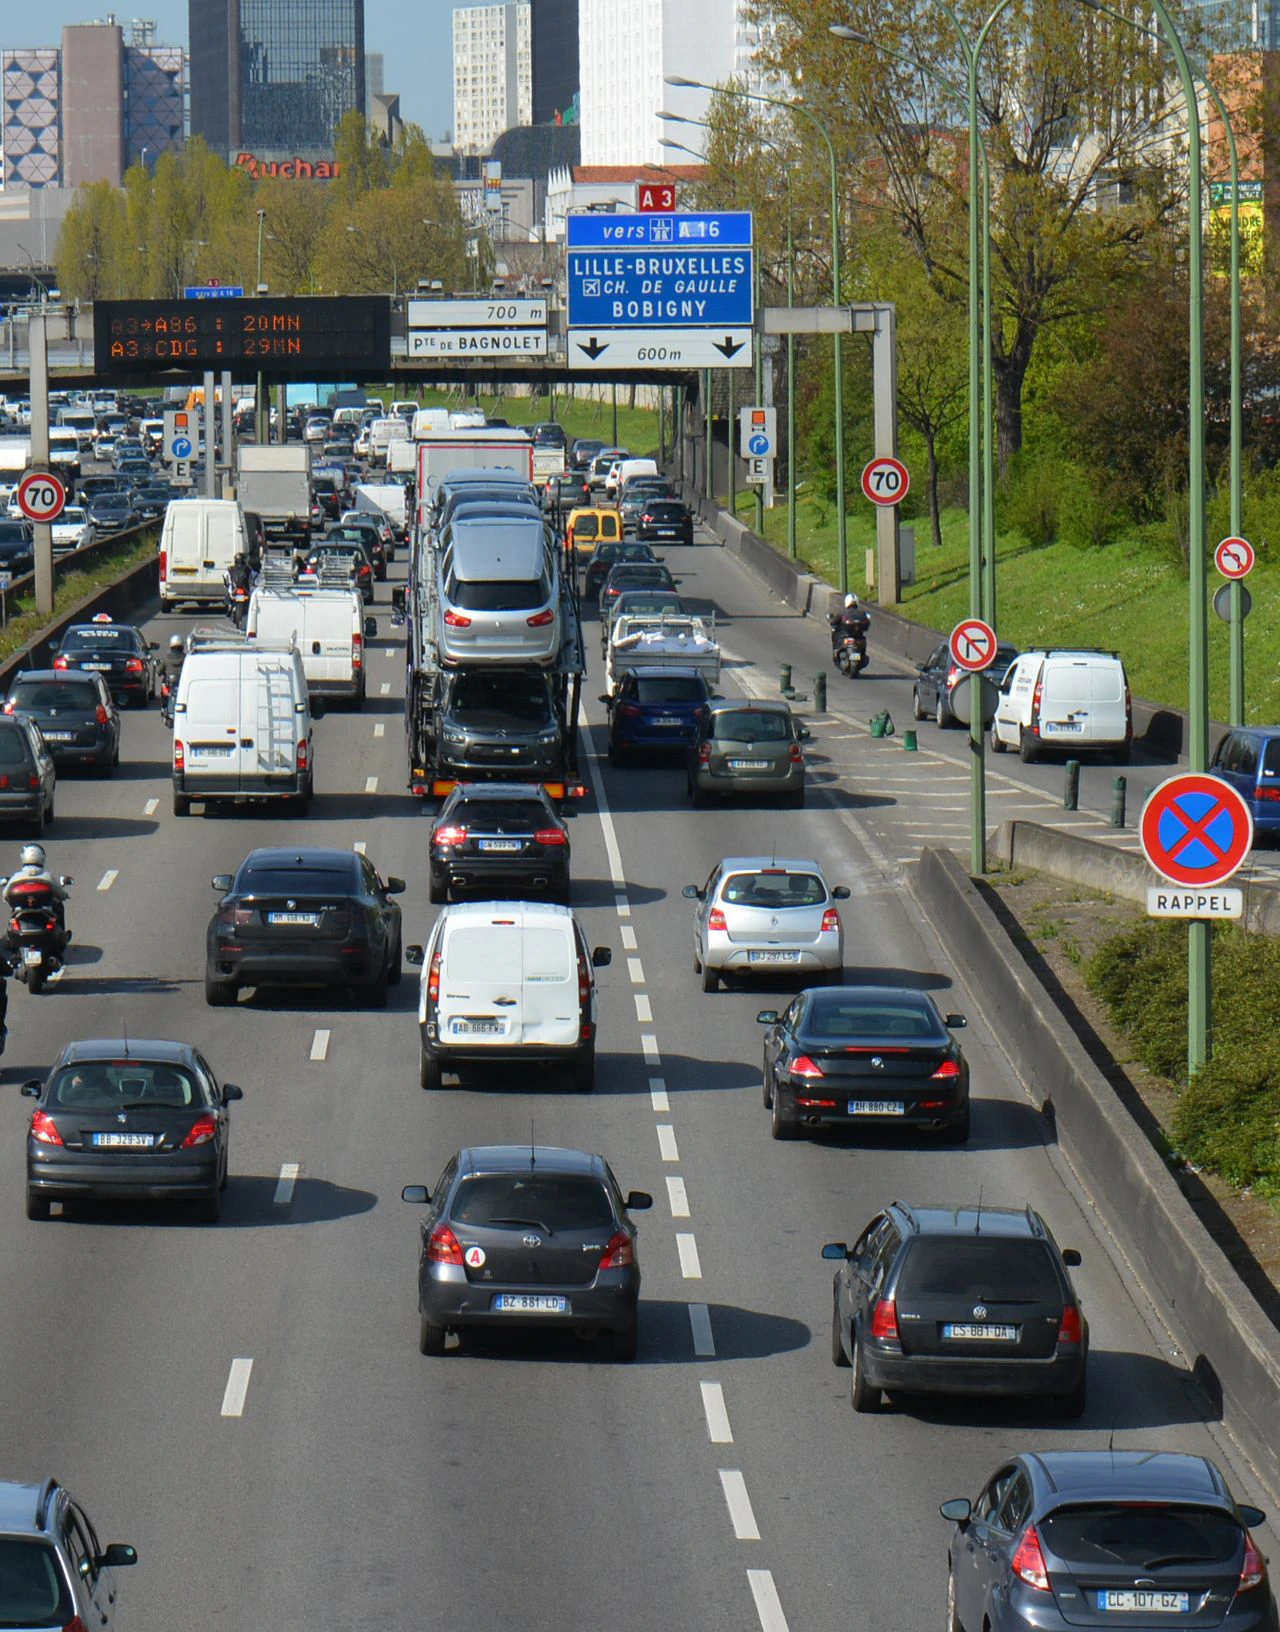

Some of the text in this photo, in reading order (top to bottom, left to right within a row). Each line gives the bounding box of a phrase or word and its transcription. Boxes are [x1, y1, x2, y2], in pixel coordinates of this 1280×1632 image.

[642, 190, 673, 207] A 3
[602, 225, 646, 239] vers
[697, 221, 721, 238] 16
[574, 257, 746, 276] LILLE-BRUXELLES
[603, 279, 738, 295] CH. DE GAULLE
[487, 306, 542, 319] 700 m
[612, 300, 707, 318] BOBIGNY
[440, 341, 453, 350] DE
[459, 336, 541, 350] BAGNOLET
[176, 462, 186, 476] E
[754, 459, 763, 474] E
[873, 471, 900, 491] 70
[28, 487, 56, 507] 70
[1157, 895, 1232, 911] RAPPEL
[470, 1249, 480, 1264] A
[502, 1295, 558, 1309] BZ-881-LD
[1107, 1591, 1179, 1608] CC-107-GZ
